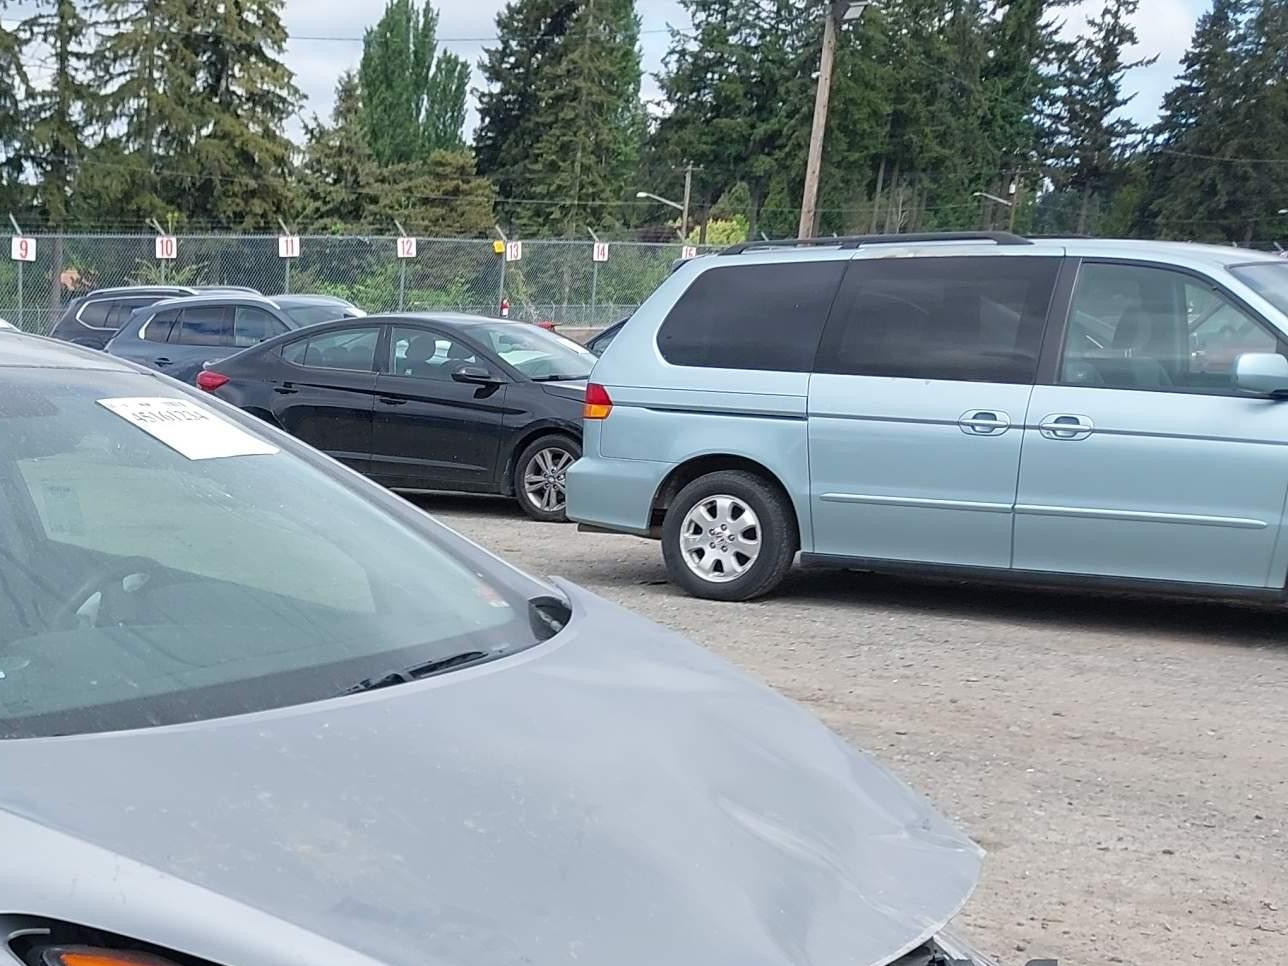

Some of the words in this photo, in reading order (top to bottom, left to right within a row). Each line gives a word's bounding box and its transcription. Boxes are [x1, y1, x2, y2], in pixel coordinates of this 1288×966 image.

[19, 239, 29, 259] 9
[159, 239, 174, 257] 10
[284, 239, 295, 256] 11
[399, 240, 413, 256] 12
[509, 243, 519, 260] 13
[596, 245, 606, 260] 14
